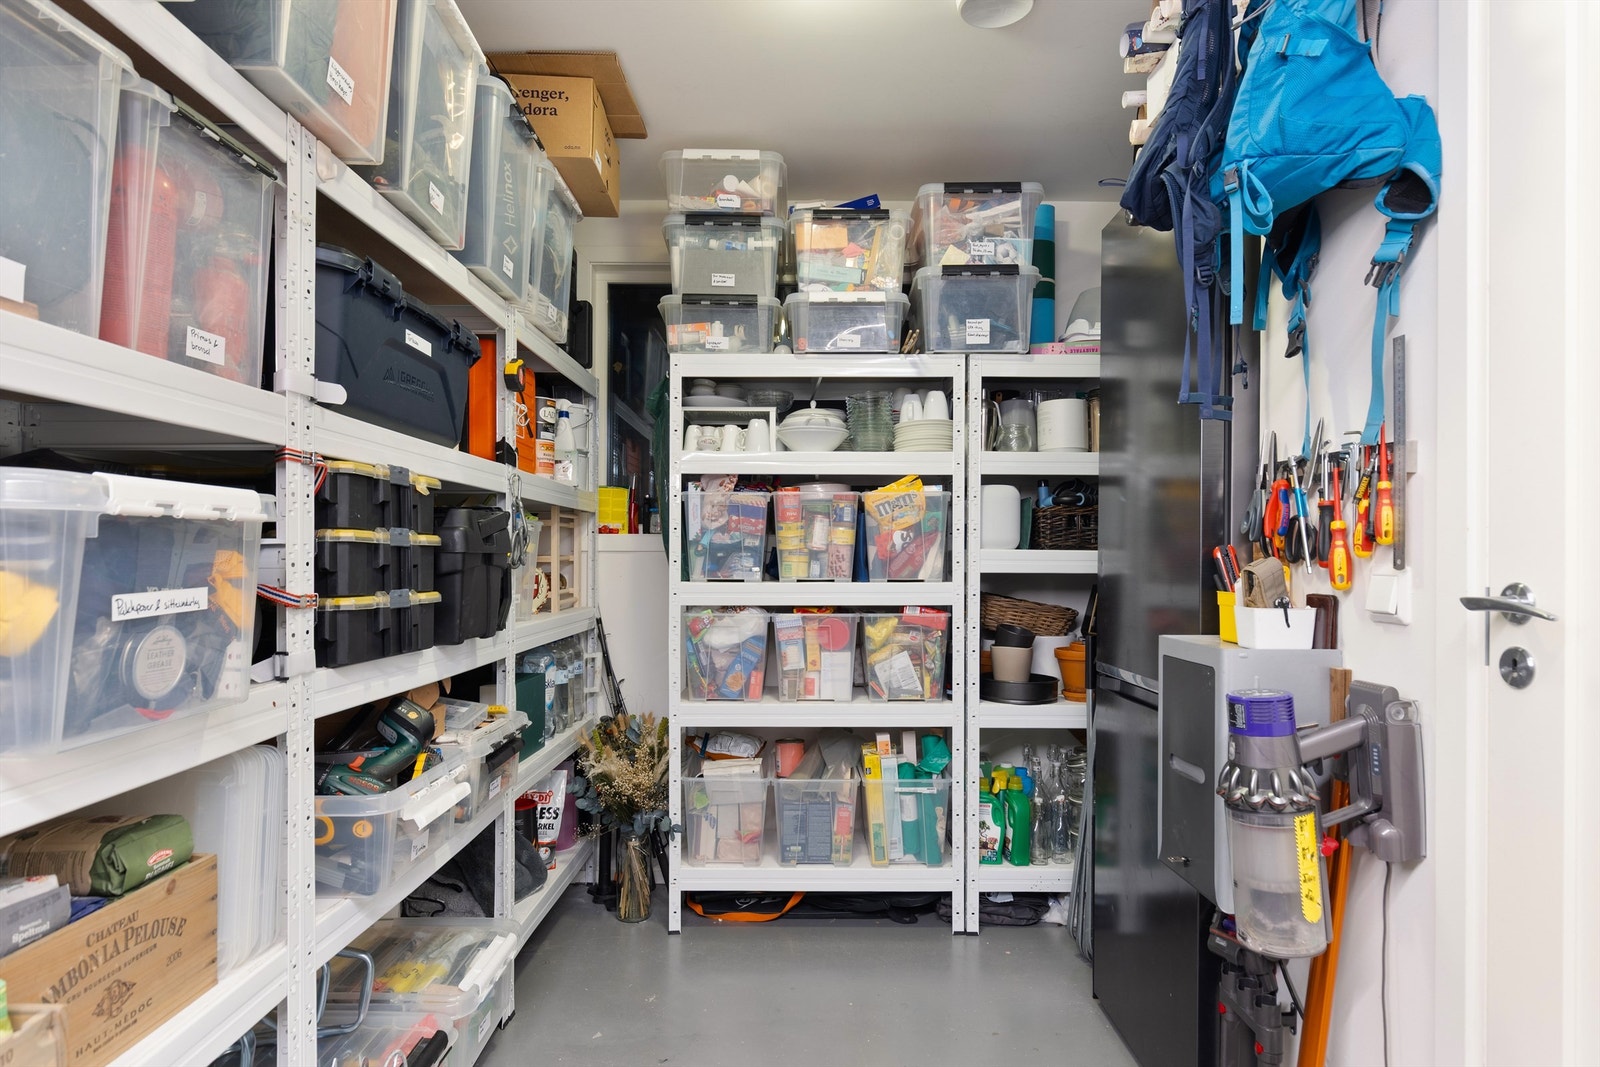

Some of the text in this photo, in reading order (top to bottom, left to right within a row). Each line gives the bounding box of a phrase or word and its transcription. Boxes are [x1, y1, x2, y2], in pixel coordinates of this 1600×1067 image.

[523, 103, 558, 116] døra
[502, 160, 516, 227] Helinox
[146, 649, 175, 660] LEATHER
[146, 660, 173, 669] GREASE
[85, 909, 140, 948] CHATEAU
[102, 938, 121, 966] LA
[122, 916, 187, 951] PELOUSE
